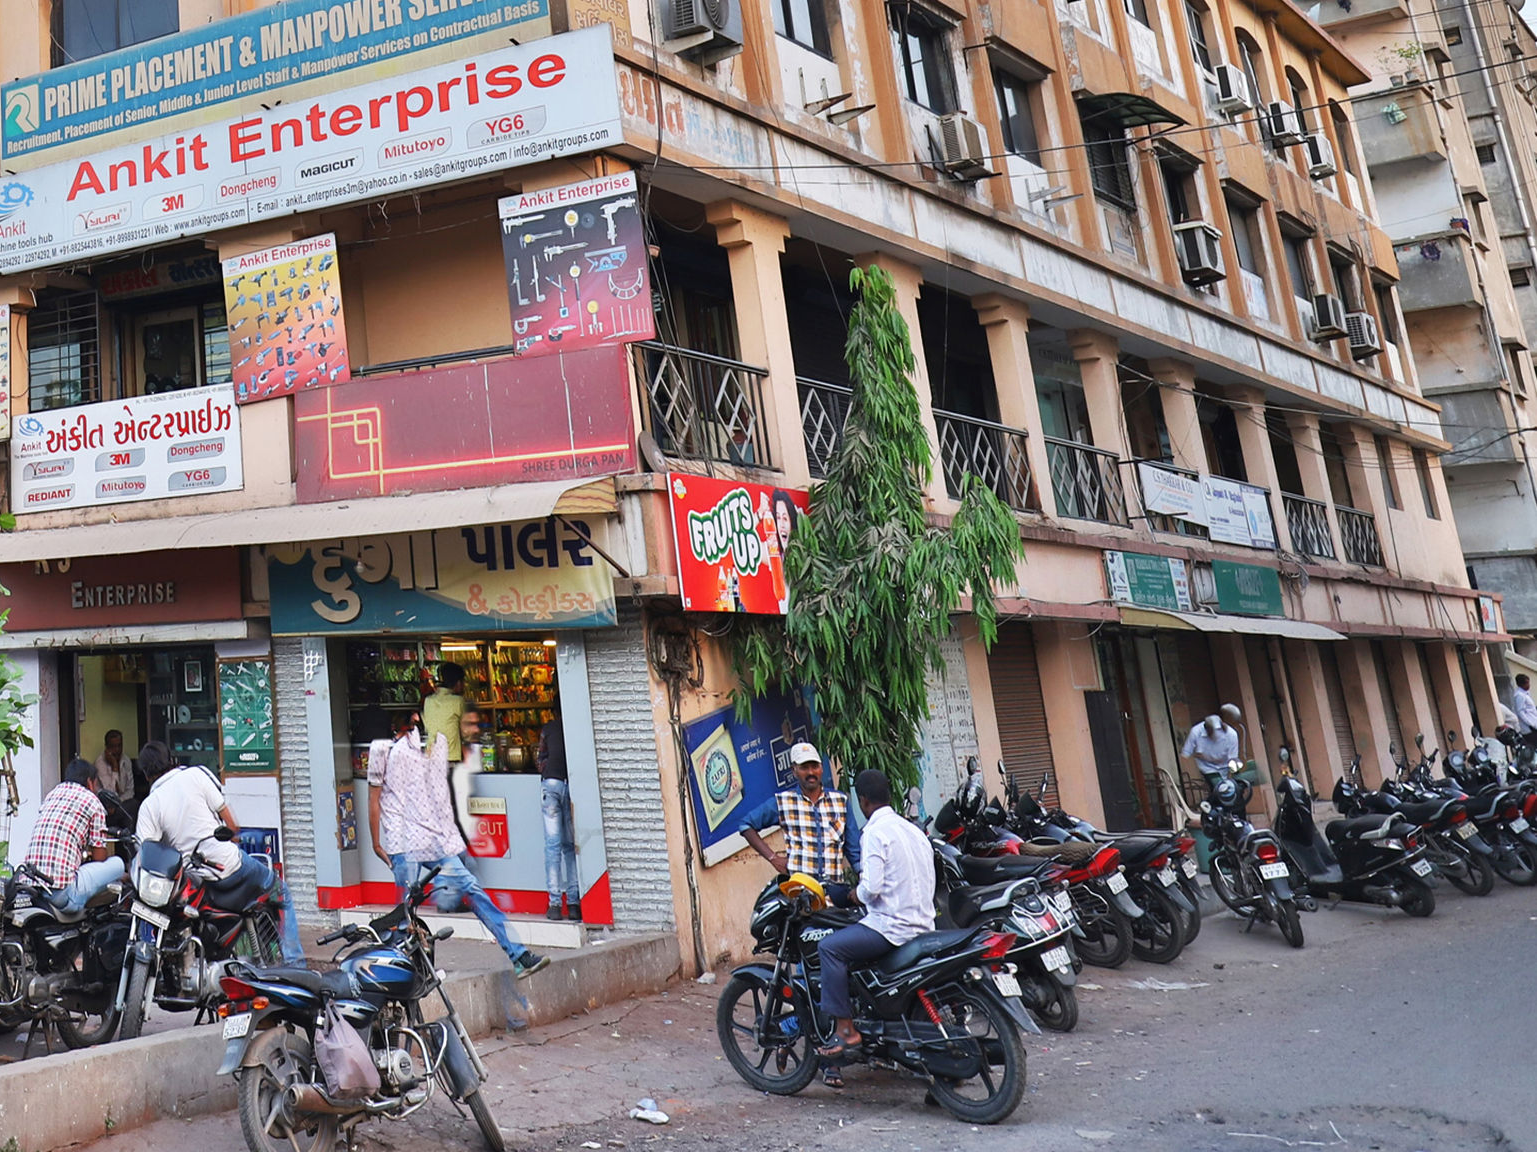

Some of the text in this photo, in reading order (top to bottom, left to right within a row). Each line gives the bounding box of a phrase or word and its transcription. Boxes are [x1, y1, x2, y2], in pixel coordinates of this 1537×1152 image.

[6, 0, 540, 155] Recruitment, Placement of Senior, Middle & Junior Level Staff & Manpower Services on Contractual Basis
[44, 73, 108, 121] PRIME
[110, 35, 234, 104] PLACEMENT
[238, 36, 257, 68] &
[66, 133, 210, 203] Ankit
[227, 52, 568, 164] Enterprise
[485, 114, 525, 137] YG6
[384, 135, 446, 160] Mitutoyo
[155, 224, 170, 235] Web
[173, 207, 246, 232] www.ankitgroups.com
[256, 198, 279, 214] E-mail
[413, 150, 508, 181] sales@ankitgroups.com
[513, 127, 610, 158] info@ankitgroups.com
[220, 174, 277, 198] Dongcheng
[518, 175, 631, 210] Ankit Enterprise
[161, 193, 185, 213] 3M
[18, 236, 38, 249] tools
[38, 232, 54, 245] hub
[238, 236, 332, 270] Ankit Enterprise
[20, 441, 42, 453] Ankit
[170, 441, 223, 457] Dongcheng
[109, 452, 131, 466] 3M
[521, 453, 625, 473] SHREE DURGA PAN
[101, 481, 146, 493] Mitutoyo
[184, 469, 211, 482] YG6
[27, 488, 72, 503] REDIANT
[688, 488, 754, 564] FRUITS
[732, 532, 762, 576] UP
[465, 583, 490, 615] &
[477, 821, 504, 836] CUT
